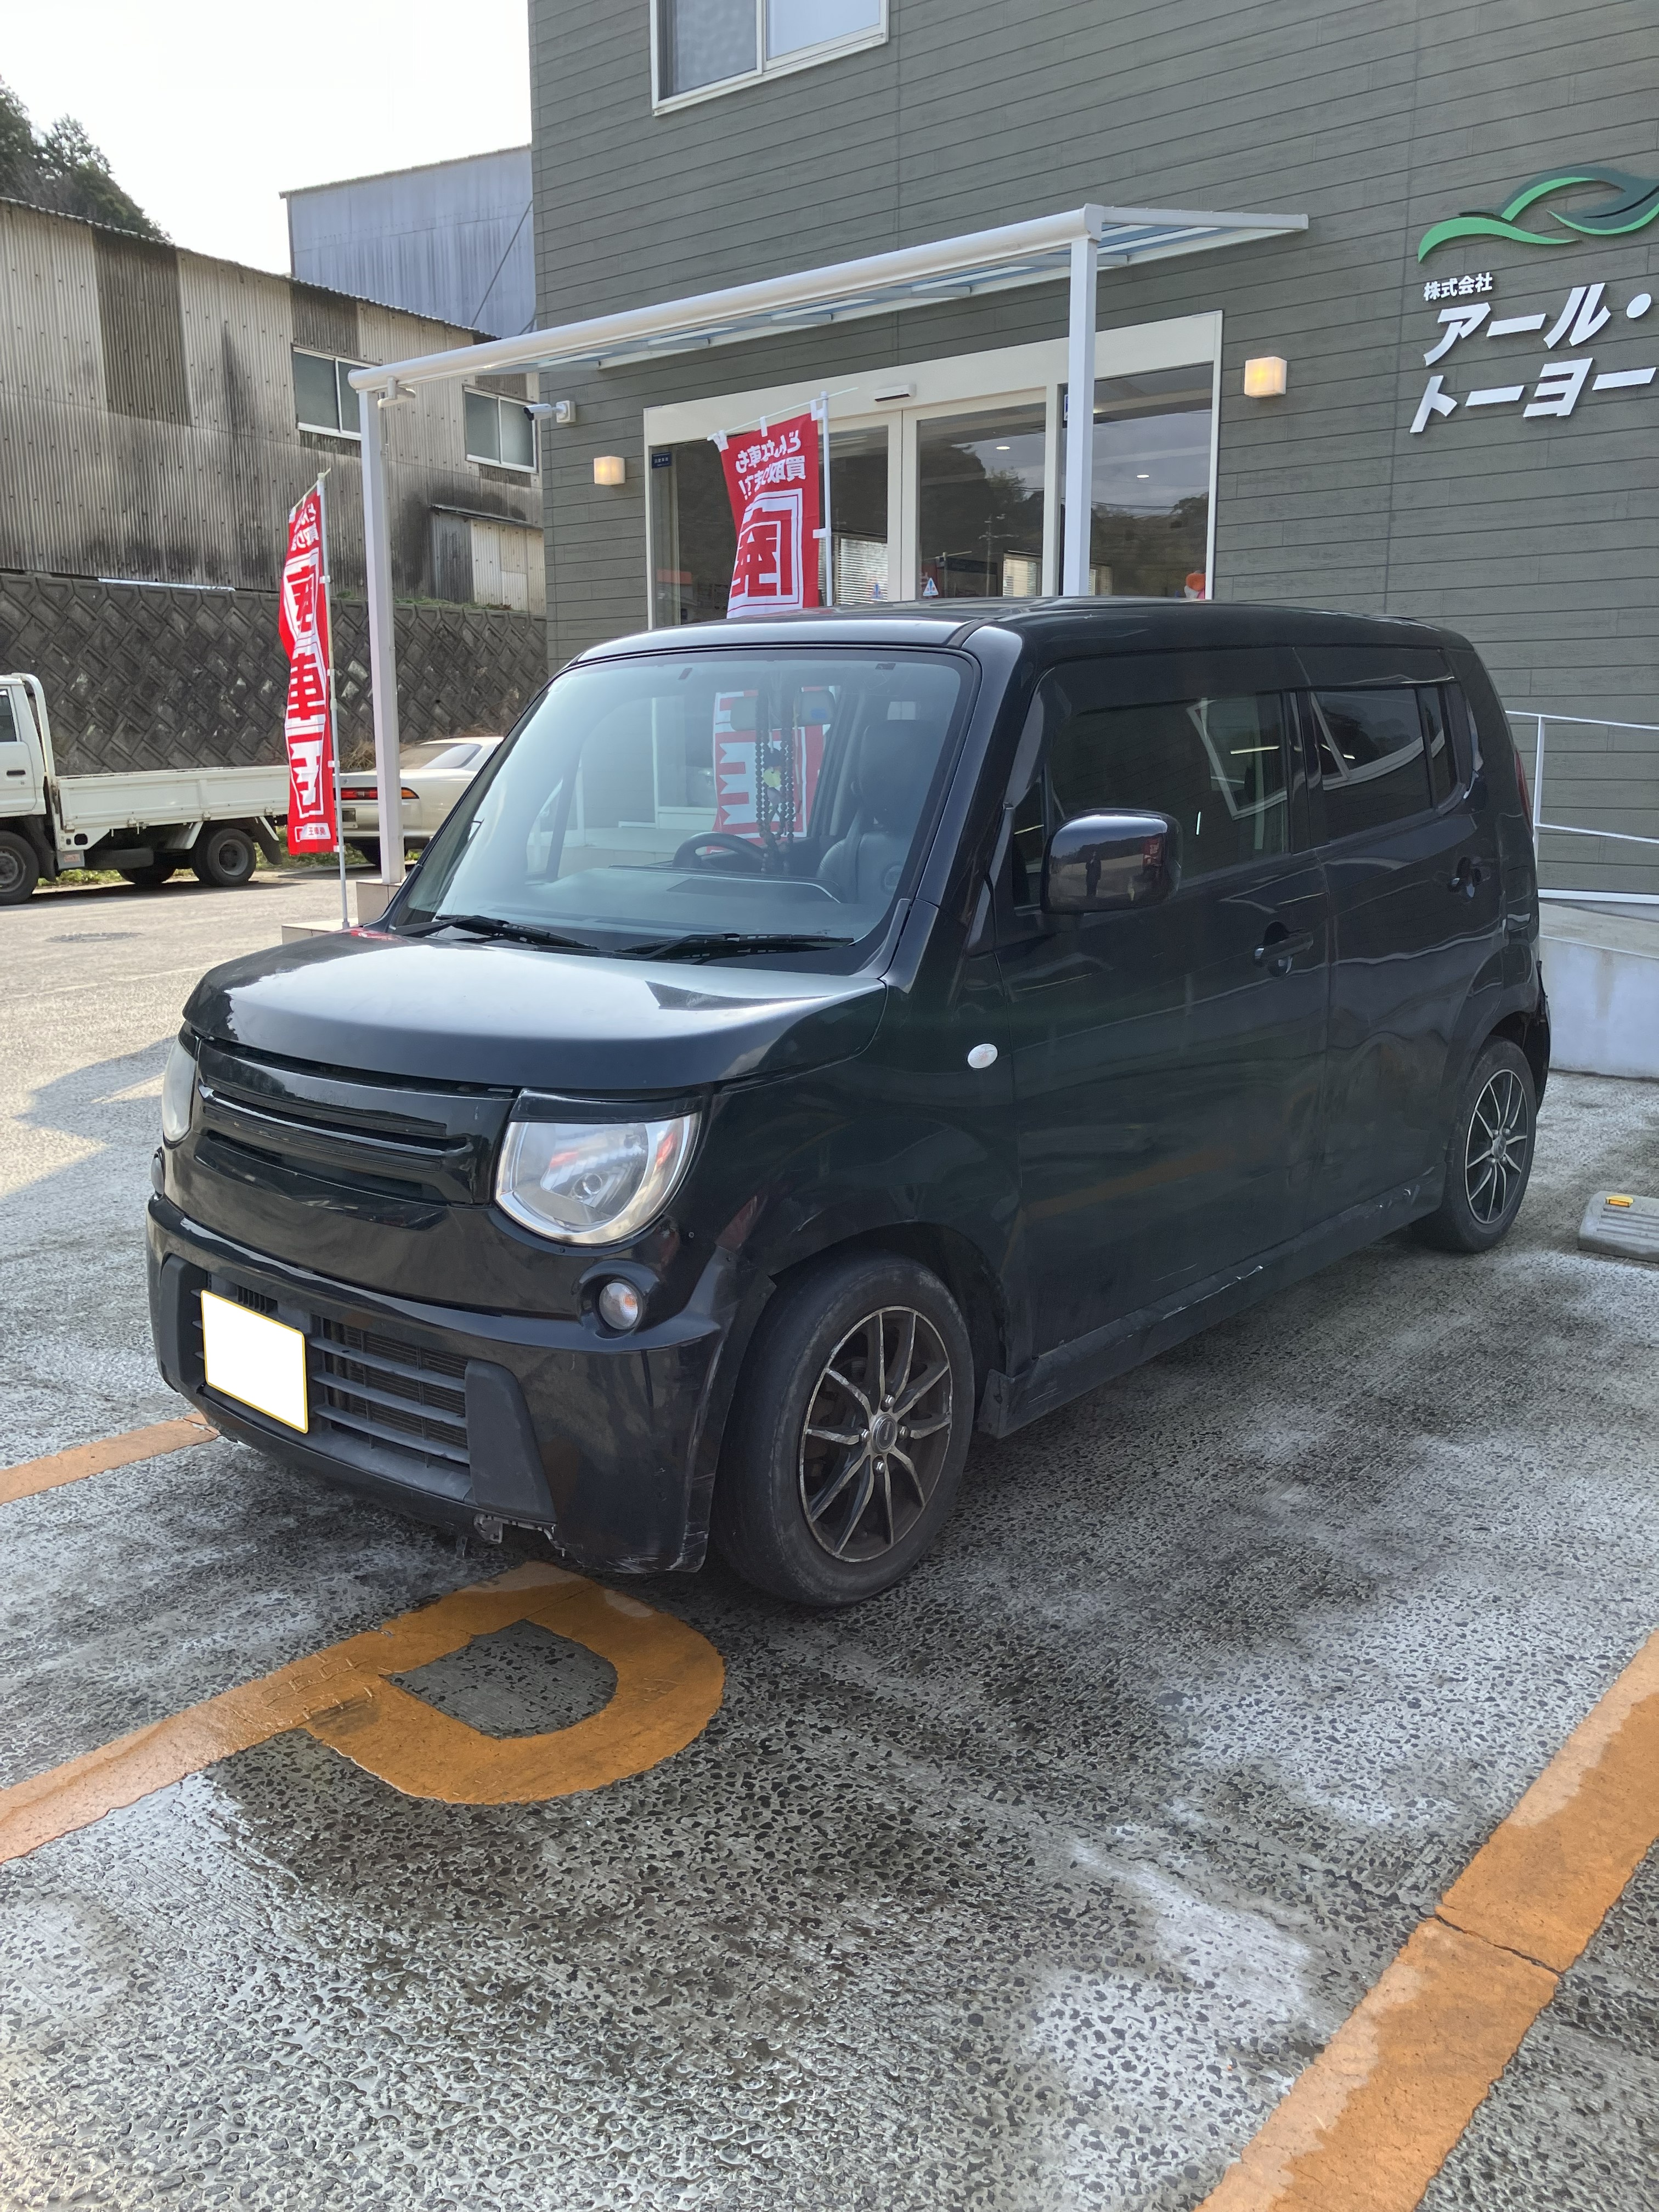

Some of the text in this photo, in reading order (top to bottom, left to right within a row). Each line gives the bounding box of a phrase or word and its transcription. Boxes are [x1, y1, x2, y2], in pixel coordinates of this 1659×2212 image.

[1424, 272, 1492, 301] 株式会社
[1409, 358, 1656, 433] トーヨー
